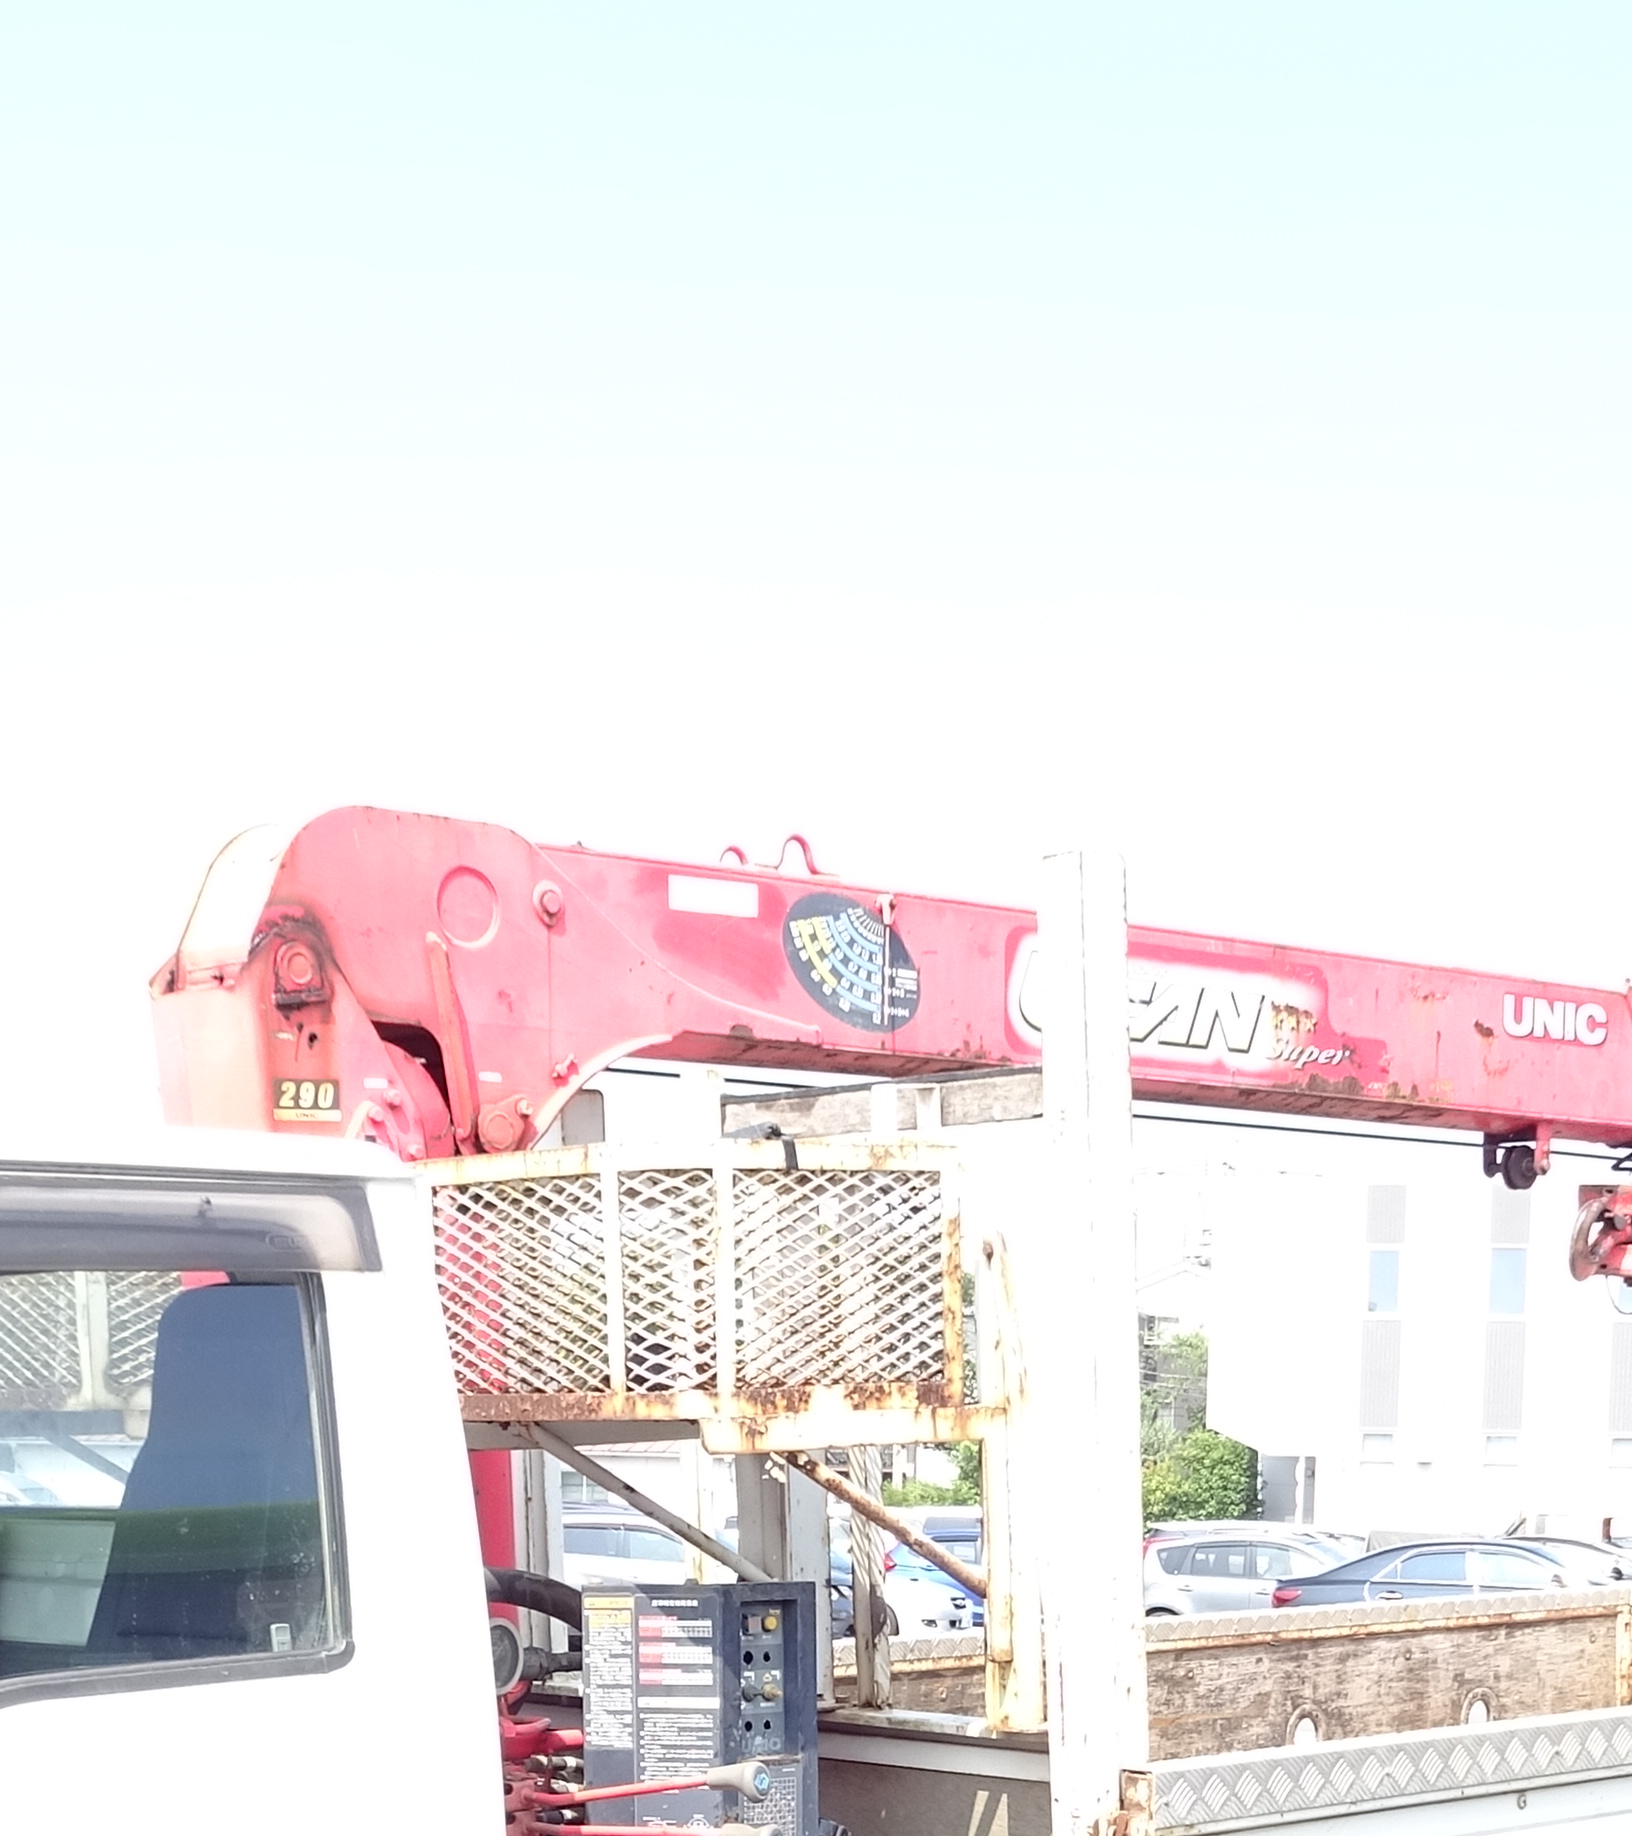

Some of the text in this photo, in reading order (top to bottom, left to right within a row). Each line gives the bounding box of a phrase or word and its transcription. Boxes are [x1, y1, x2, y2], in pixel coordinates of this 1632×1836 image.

[1502, 992, 1609, 1048] UNIC
[1265, 1038, 1351, 1070] Super
[279, 1081, 335, 1109] 290
